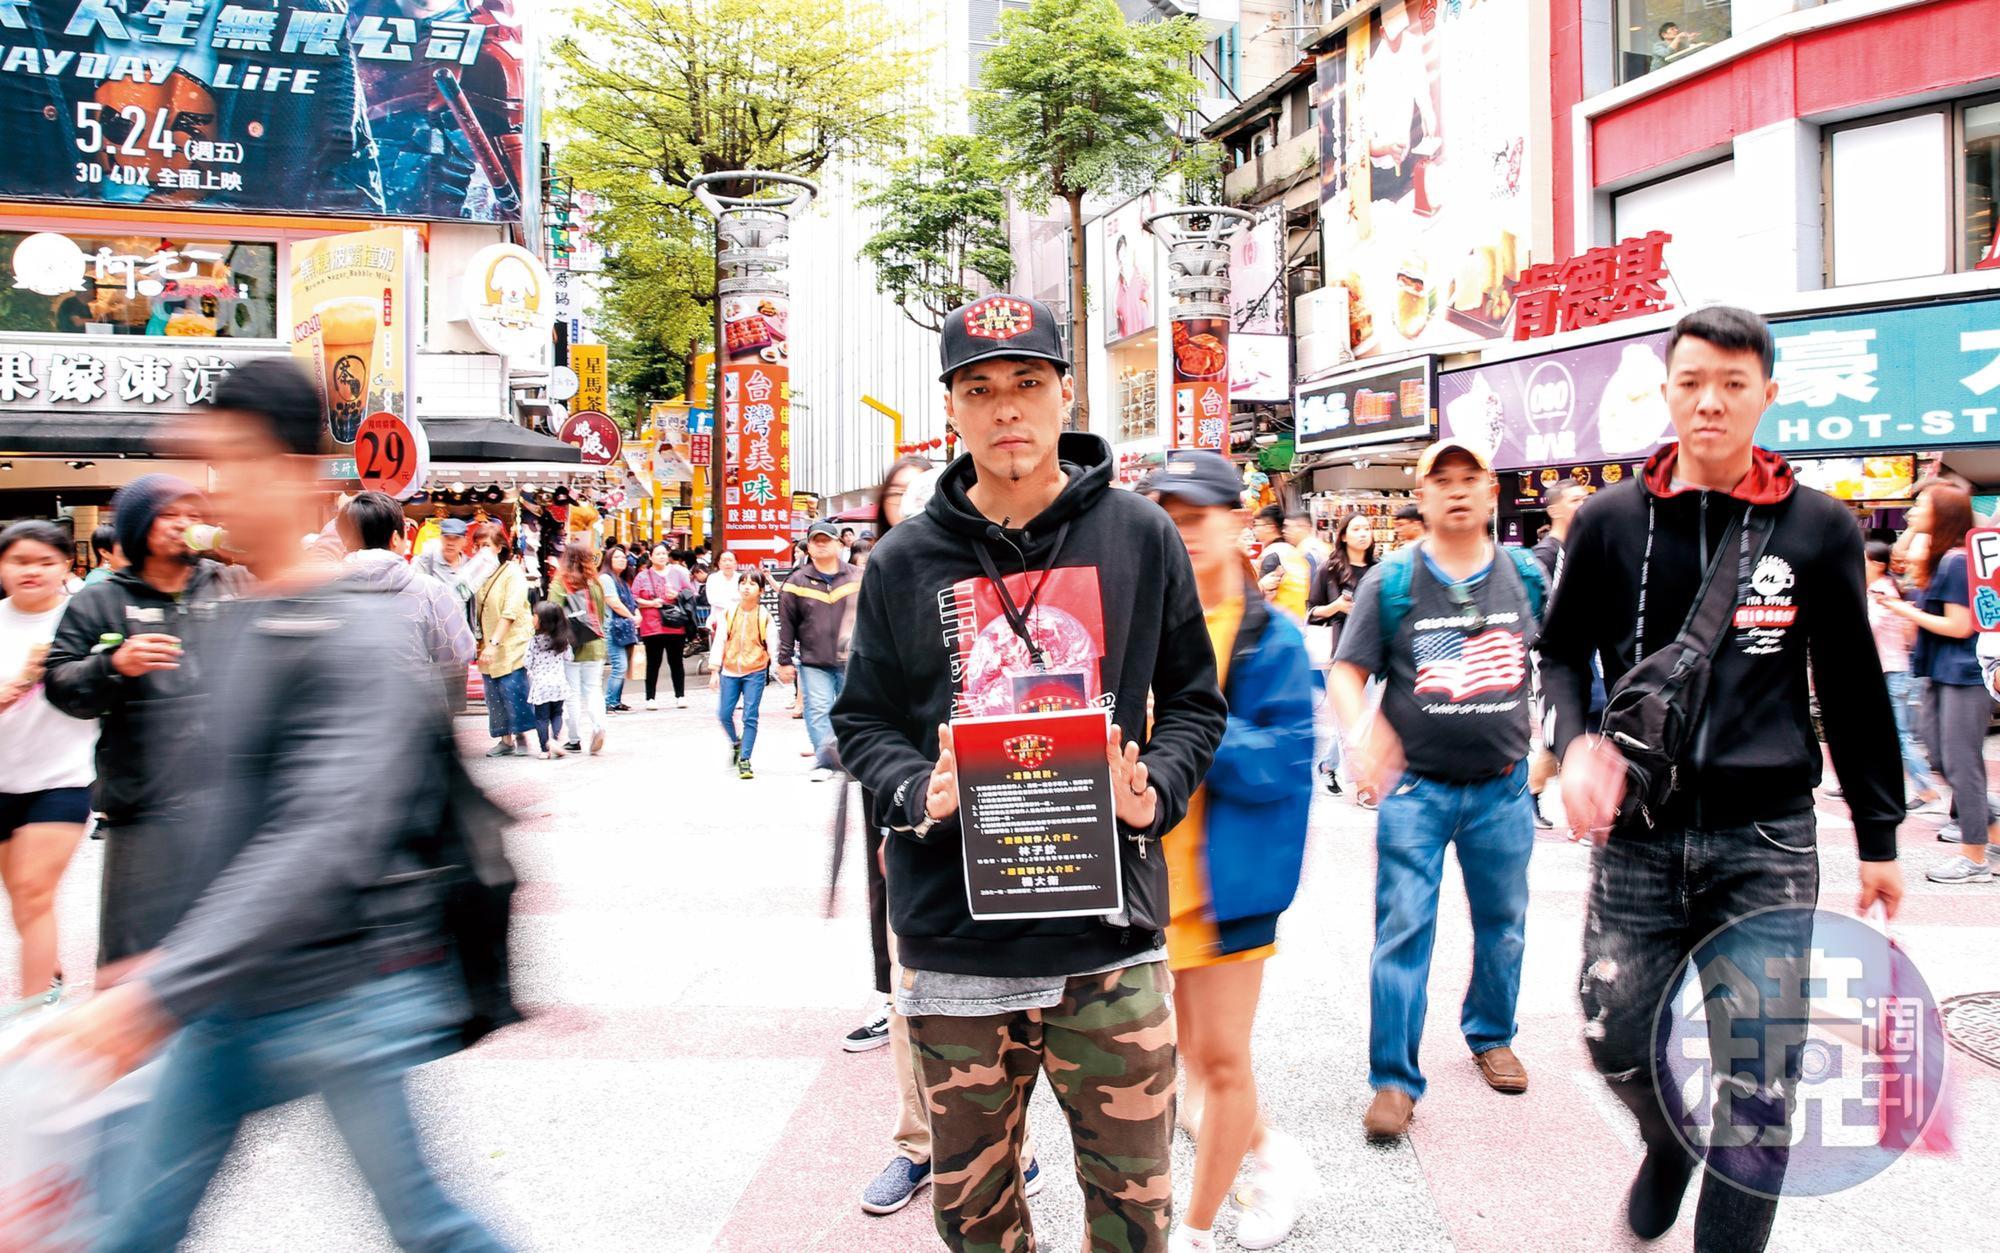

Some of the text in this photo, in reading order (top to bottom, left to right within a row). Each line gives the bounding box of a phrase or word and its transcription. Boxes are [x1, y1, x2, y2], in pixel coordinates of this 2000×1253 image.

[0, 45, 176, 84] AYDAY
[75, 100, 244, 164] 5.24 (週五)
[76, 162, 243, 191] 3D 4DX 全面上映
[1512, 230, 1676, 341] 肯德基
[742, 369, 777, 507] 台灣美味
[1199, 386, 1223, 449] 台灣
[1777, 406, 1998, 442] HOT-ST
[329, 462, 358, 476] 茶研
[361, 431, 405, 480] 29
